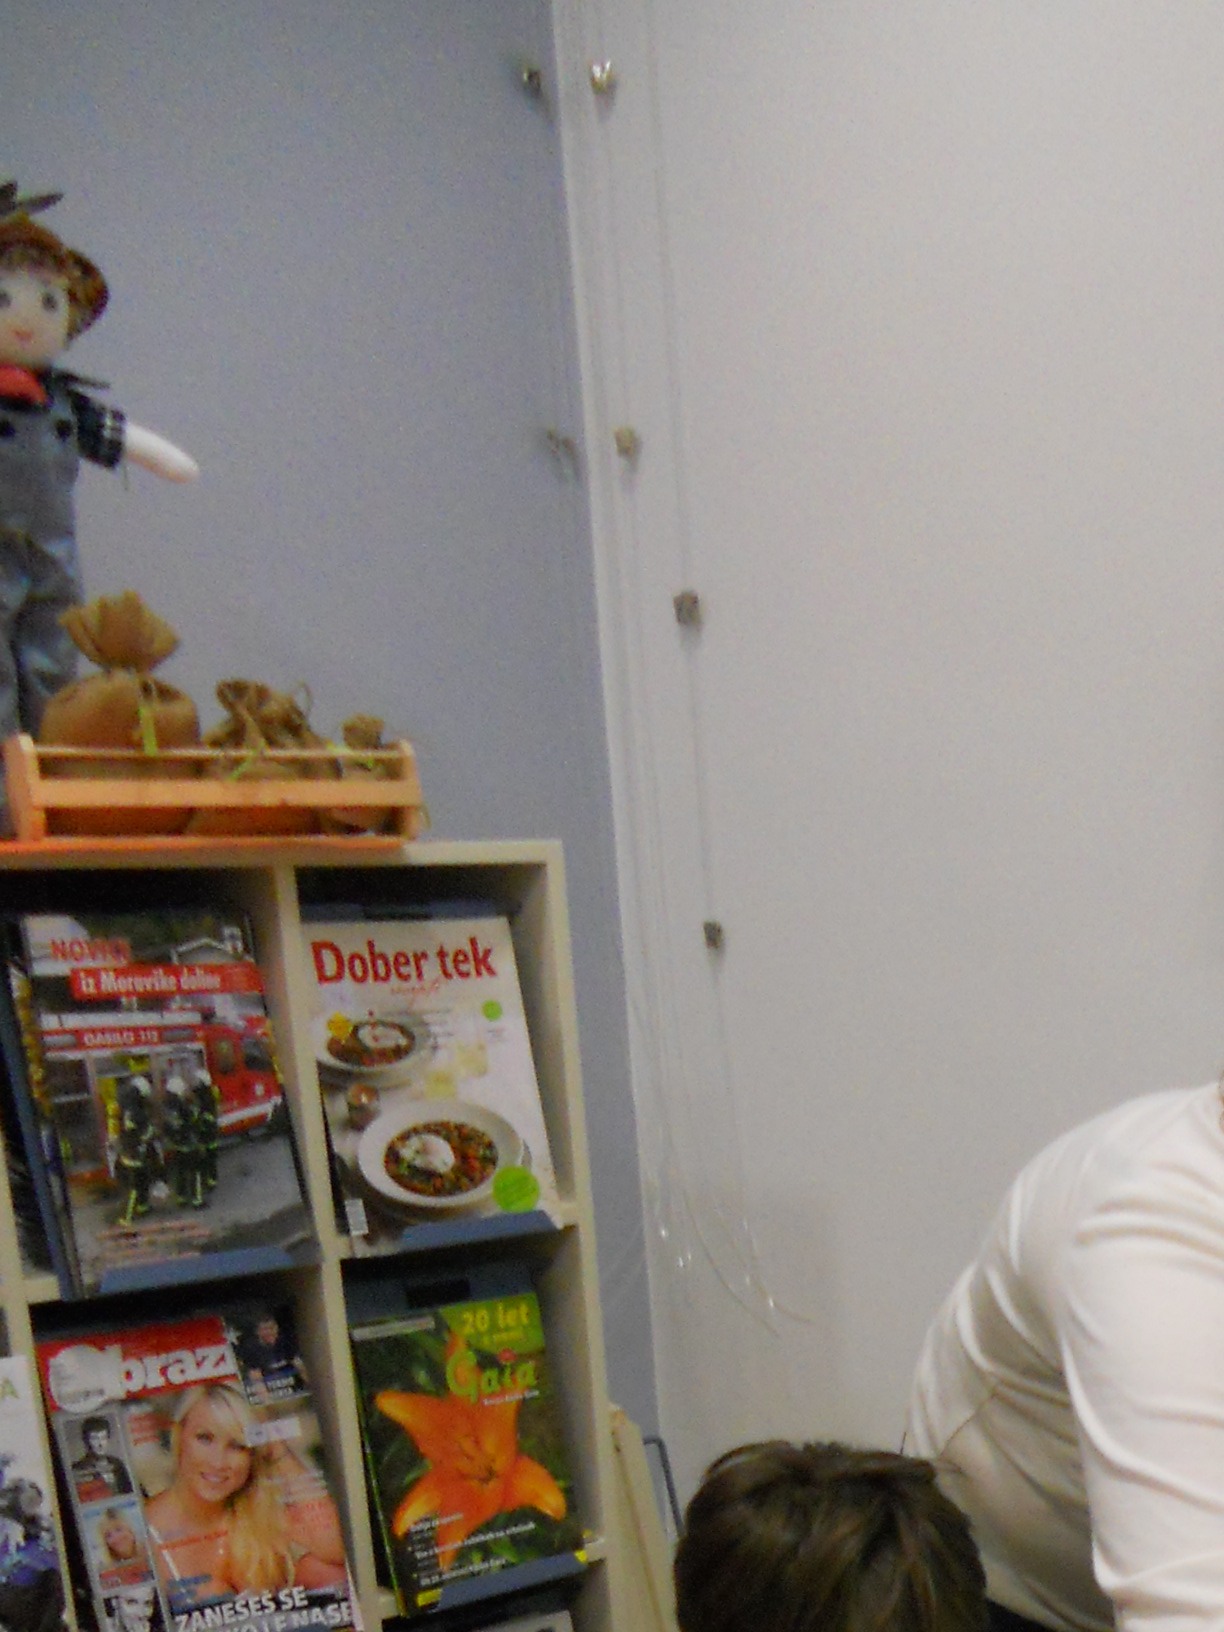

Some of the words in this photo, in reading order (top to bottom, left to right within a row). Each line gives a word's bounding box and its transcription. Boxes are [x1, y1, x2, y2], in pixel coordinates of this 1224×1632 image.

[311, 938, 428, 985] Dober
[436, 936, 498, 980] tek
[277, 1586, 309, 1610] SE
